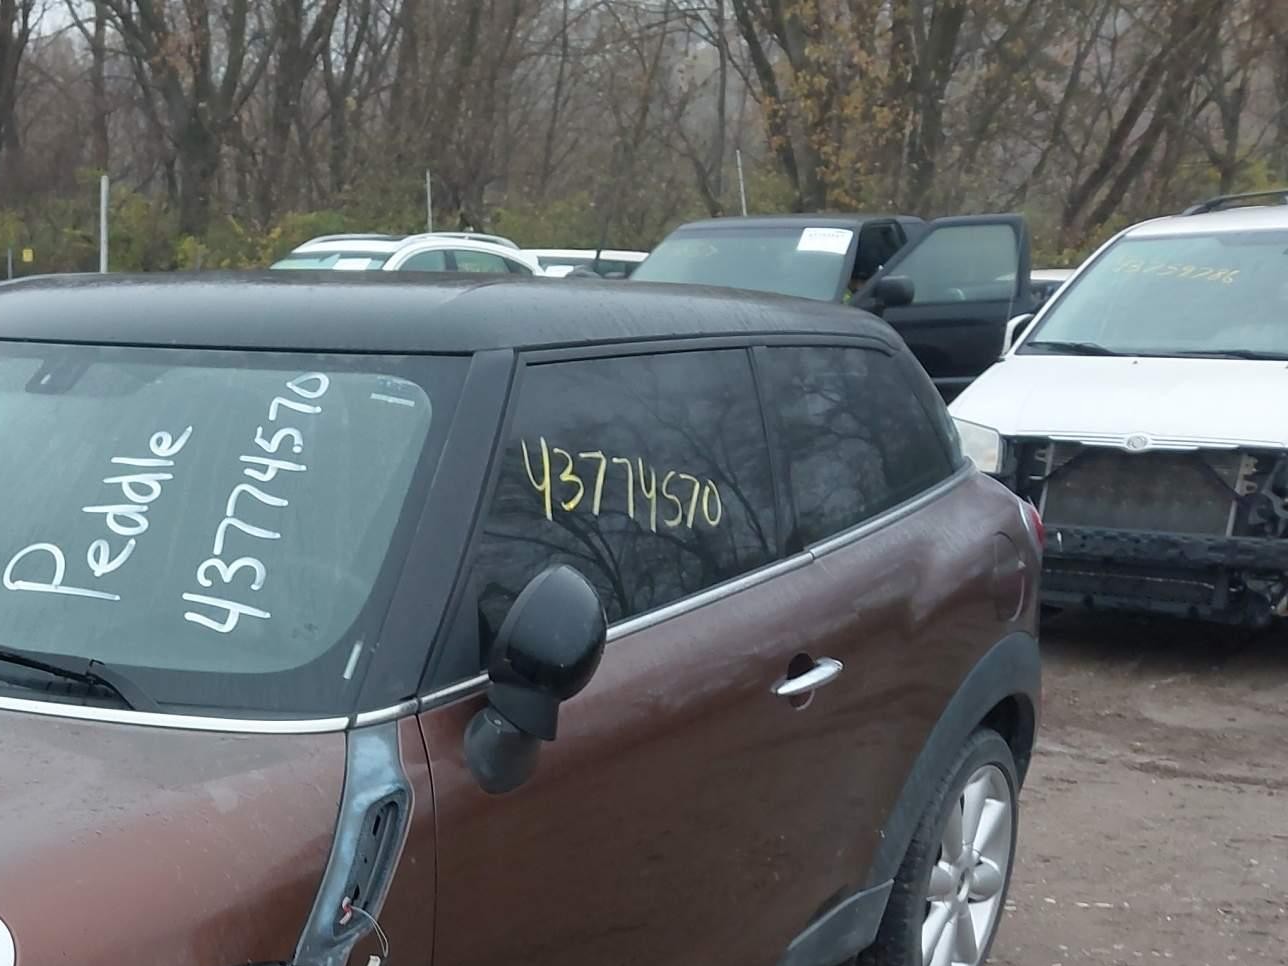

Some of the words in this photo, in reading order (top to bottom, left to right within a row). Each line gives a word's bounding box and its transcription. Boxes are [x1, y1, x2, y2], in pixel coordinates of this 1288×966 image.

[3, 425, 193, 601] Peddle
[182, 371, 331, 633] 43774570
[520, 436, 723, 534] 43774570
